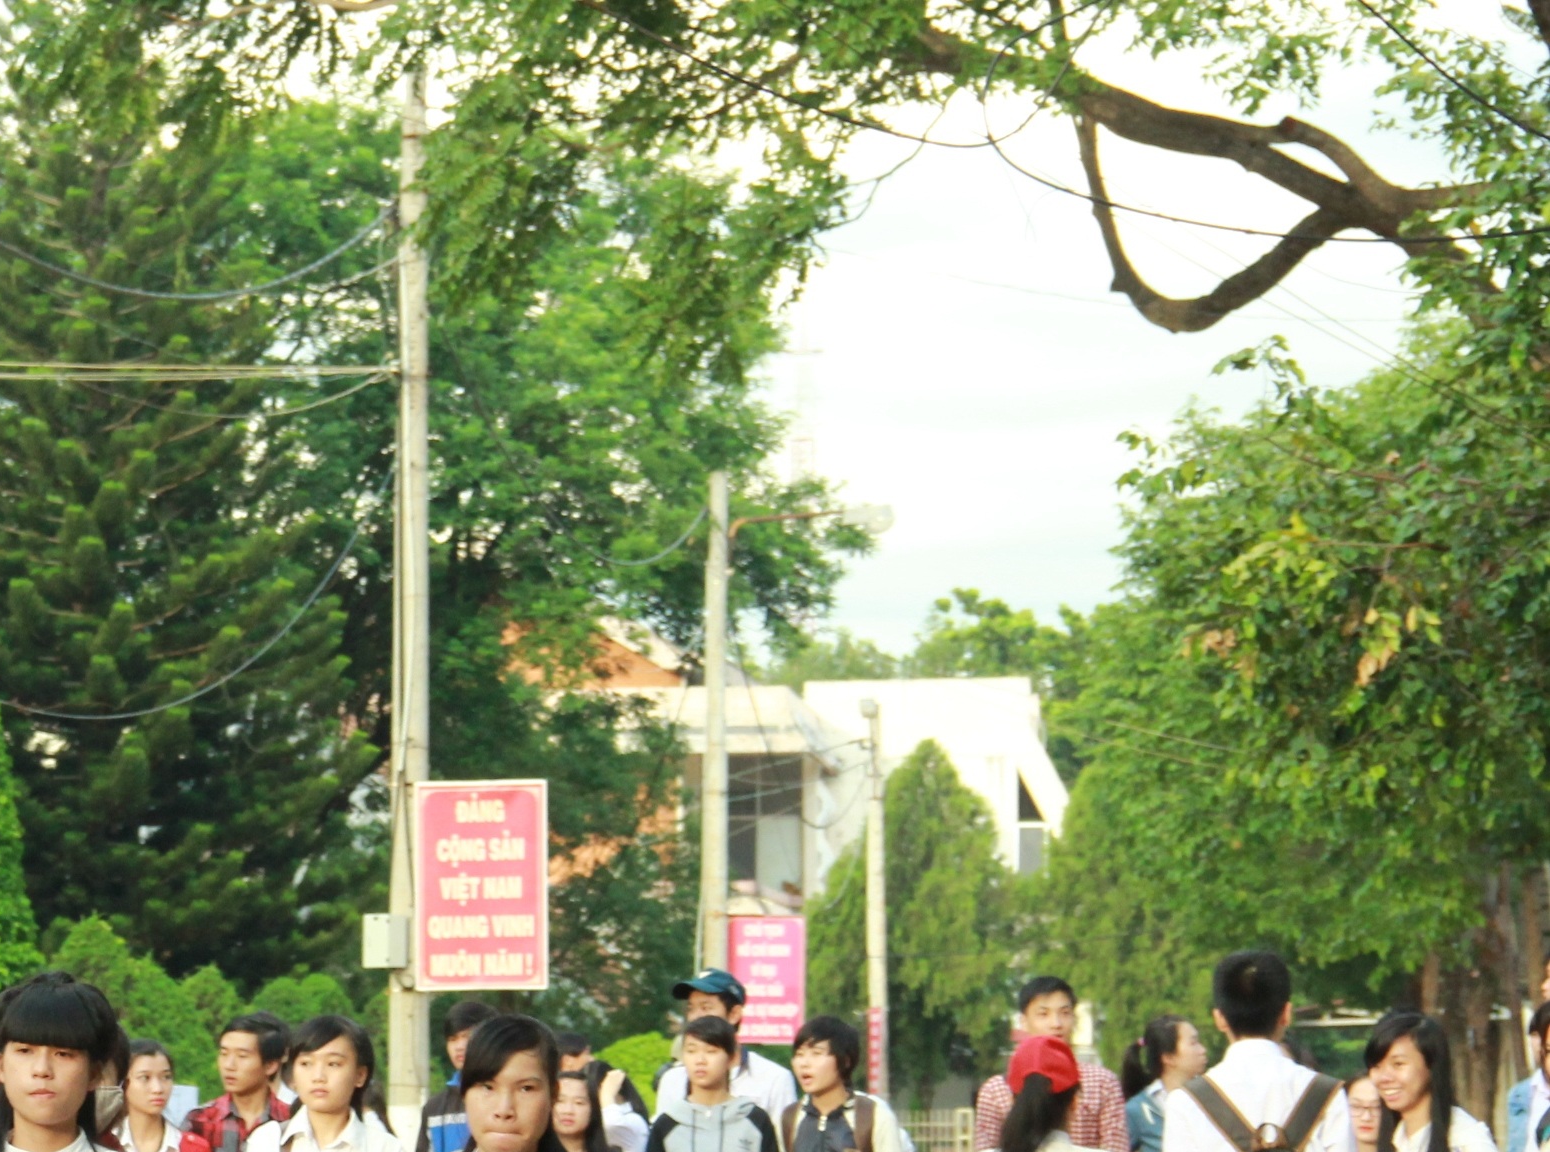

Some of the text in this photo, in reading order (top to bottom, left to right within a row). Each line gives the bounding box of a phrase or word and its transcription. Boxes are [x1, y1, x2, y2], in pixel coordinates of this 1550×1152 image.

[436, 830, 526, 868] CỘNG SẢN
[439, 872, 522, 906] VIỆT NAM
[428, 914, 534, 939] QUANG VINH
[430, 949, 481, 977] MUÔN
[483, 948, 523, 976] NĂM
